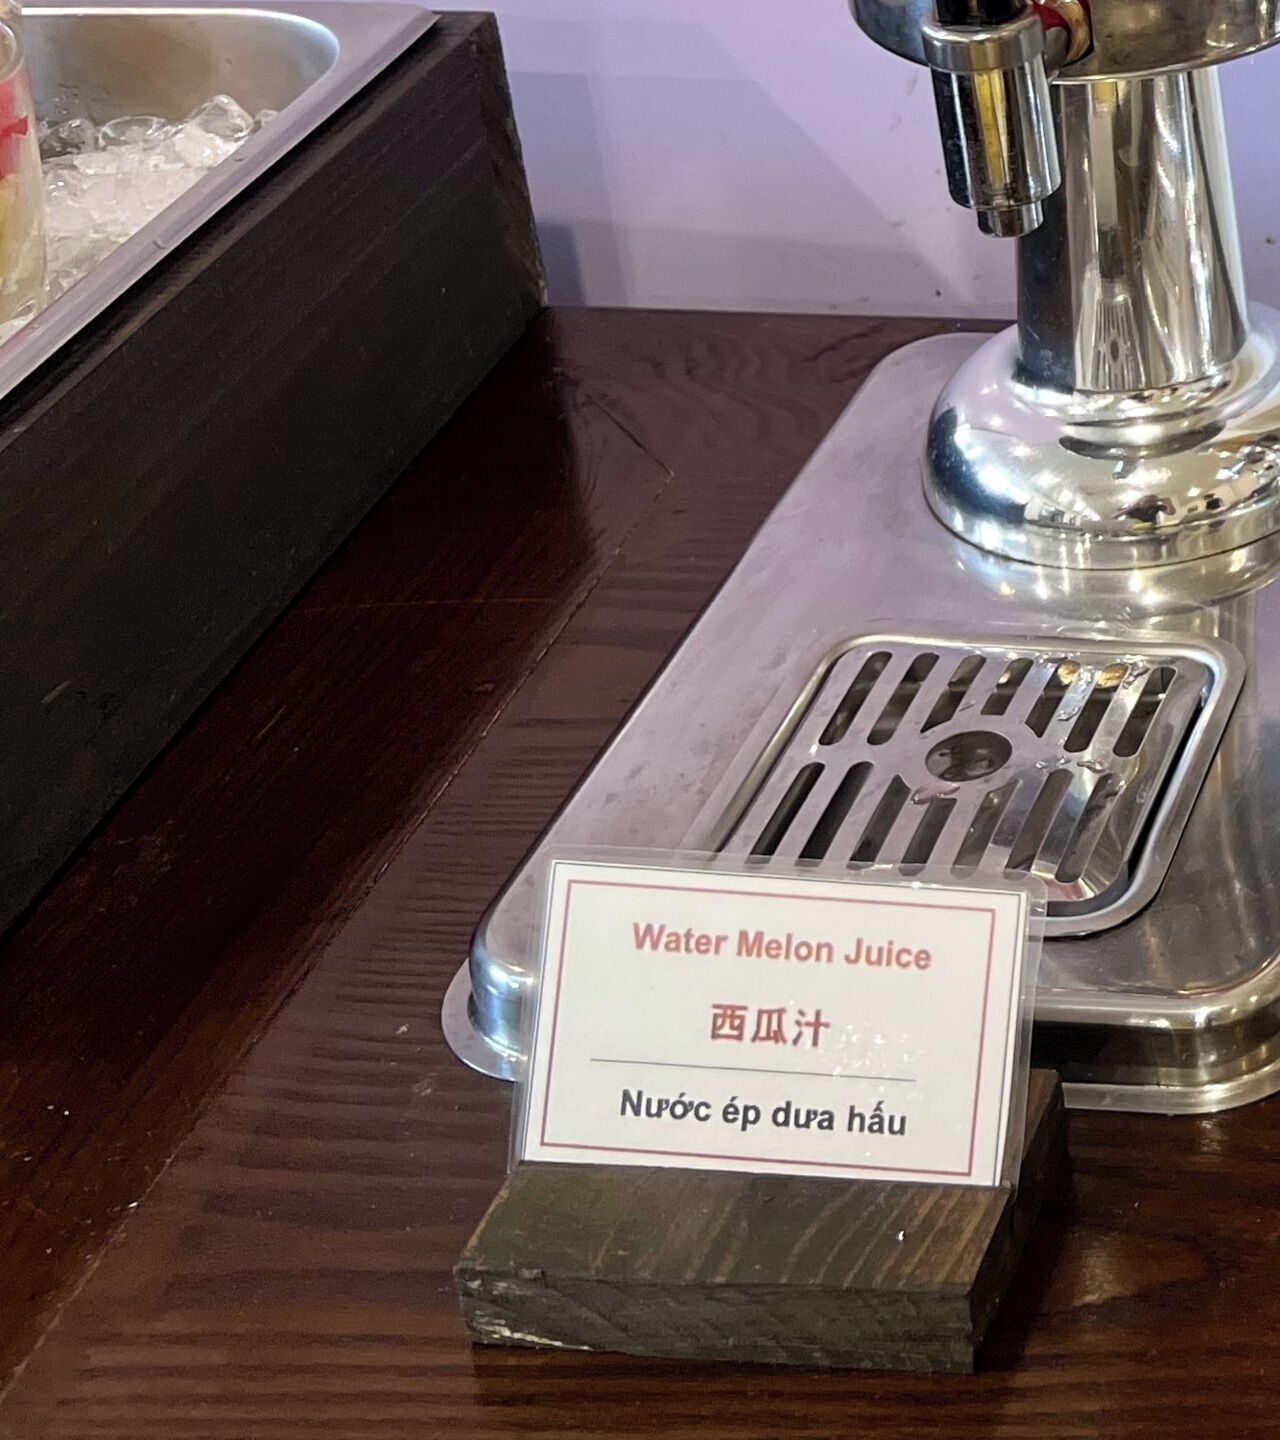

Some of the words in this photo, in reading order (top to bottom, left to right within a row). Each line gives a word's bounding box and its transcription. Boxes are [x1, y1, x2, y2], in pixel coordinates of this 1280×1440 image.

[633, 922, 729, 956] Water
[736, 929, 834, 964] Melon
[844, 937, 932, 971] Juice
[710, 1003, 831, 1048] 西瓜汁
[619, 1088, 712, 1123] Nước
[721, 1095, 762, 1133] ép
[771, 1100, 835, 1132] dưa
[846, 1099, 907, 1137] hấu
